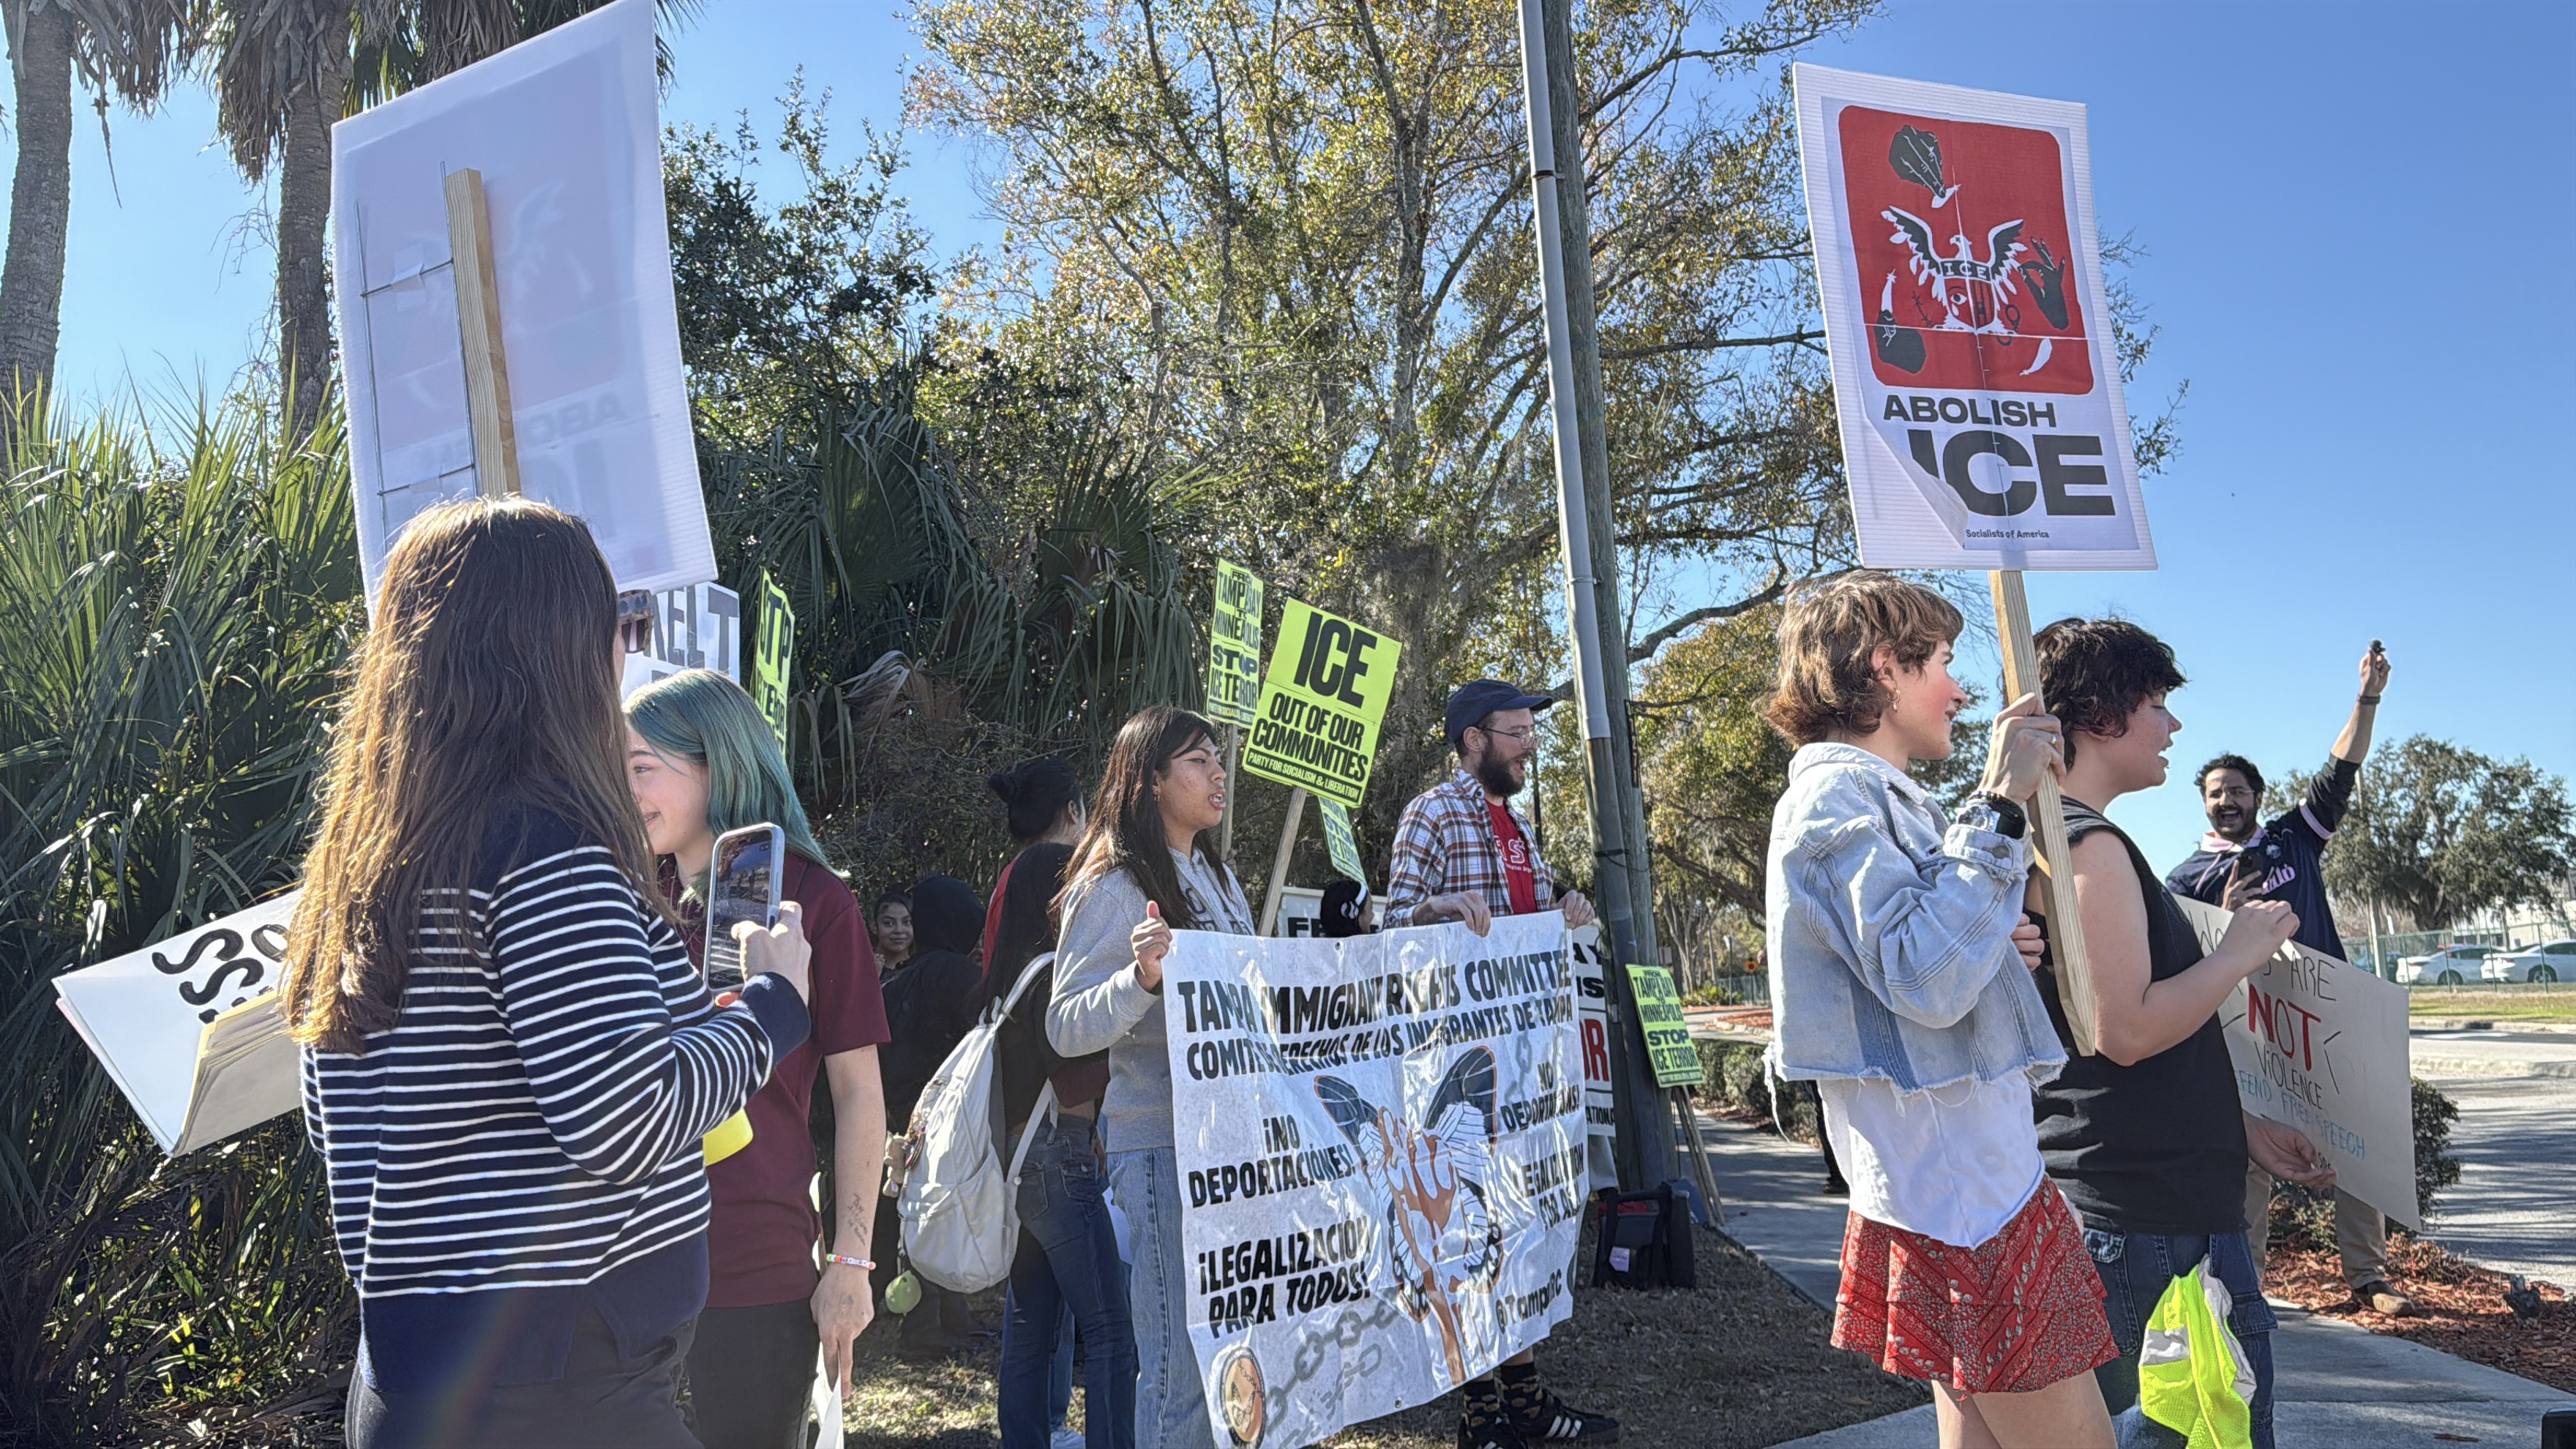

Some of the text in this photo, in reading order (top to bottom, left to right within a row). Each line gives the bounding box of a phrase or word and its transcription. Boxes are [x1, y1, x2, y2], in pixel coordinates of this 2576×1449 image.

[1944, 263, 1988, 280] ICE
[1884, 395, 2056, 427] ABOLISH
[1907, 430, 2116, 516] ICE
[1966, 529, 2049, 539] Socialists of America
[1293, 611, 1377, 708] ICE
[1252, 718, 1368, 782] COMMUNITIES
[1269, 692, 1308, 728] OUT
[1306, 705, 1331, 735] OF
[1328, 714, 1365, 750] OUR
[1248, 752, 1360, 800] PARTY FOR SOCIALISM & LIBERATION
[1386, 964, 1461, 1016] RIGHTS
[1465, 949, 1572, 1002] COMMITTEE
[2291, 950, 2337, 1001] ARE
[1351, 1028, 1373, 1061] DE
[1374, 1024, 1404, 1059] LOS
[1512, 1001, 1537, 1032] DE
[1648, 1029, 1689, 1046] STOP
[2249, 984, 2321, 1071] NOT
[1538, 1061, 1554, 1092] NO
[1652, 1046, 1699, 1071] ICE TERROR
[1262, 1114, 1300, 1154] ¡NO
[2281, 1090, 2310, 1125] FREE
[2315, 1114, 2365, 1161] SPEECH
[1188, 1143, 1356, 1208] DEPORTACIÓNES!
[1199, 1212, 1371, 1295] ¡LEGALIZACIÓN
[1209, 1261, 1371, 1338] PARA TODOS!
